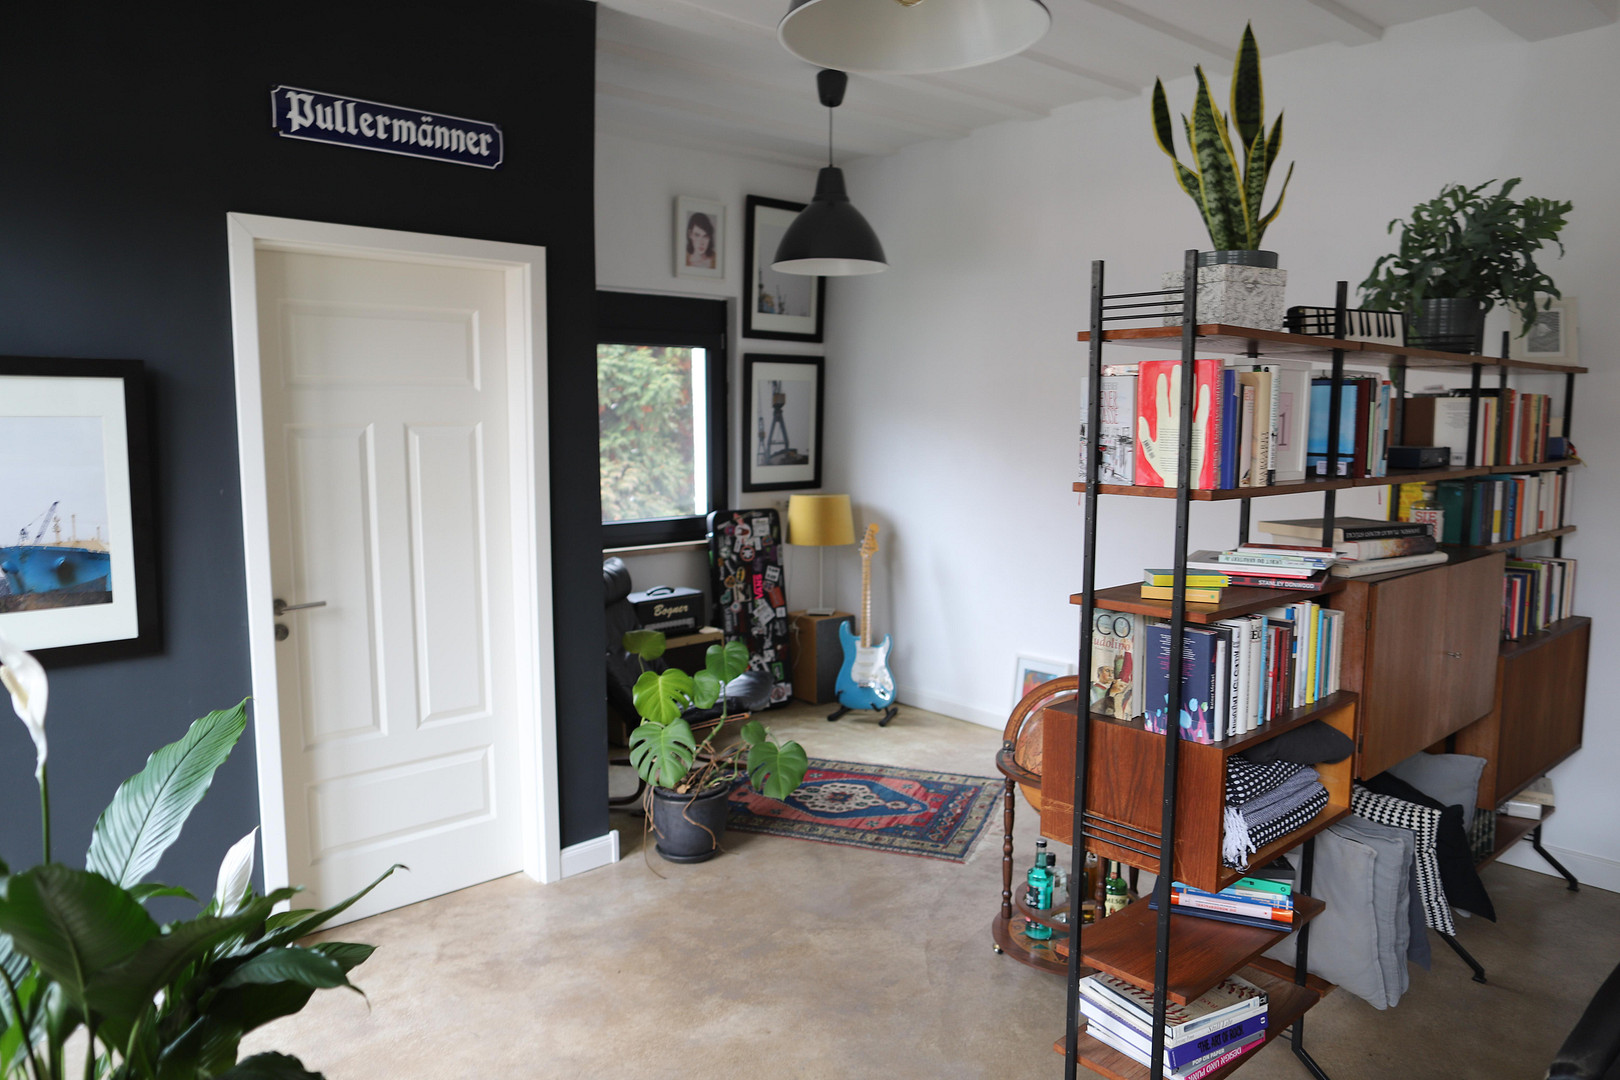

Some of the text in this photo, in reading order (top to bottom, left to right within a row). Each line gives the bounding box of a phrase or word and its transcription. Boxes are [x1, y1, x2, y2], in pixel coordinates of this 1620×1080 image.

[285, 90, 495, 157] Pullermänner
[752, 573, 764, 600] VANS
[1258, 578, 1315, 590] STANLEY DONWOOD
[653, 604, 689, 617] Bogner
[1092, 613, 1131, 638] CO
[1093, 636, 1131, 651] udolino
[1197, 1025, 1245, 1053] THE ART OF ROCK
[1192, 1048, 1226, 1066] POP ON PAPER
[1220, 1046, 1242, 1066] DESIGN
[1206, 1060, 1220, 1075] UND
